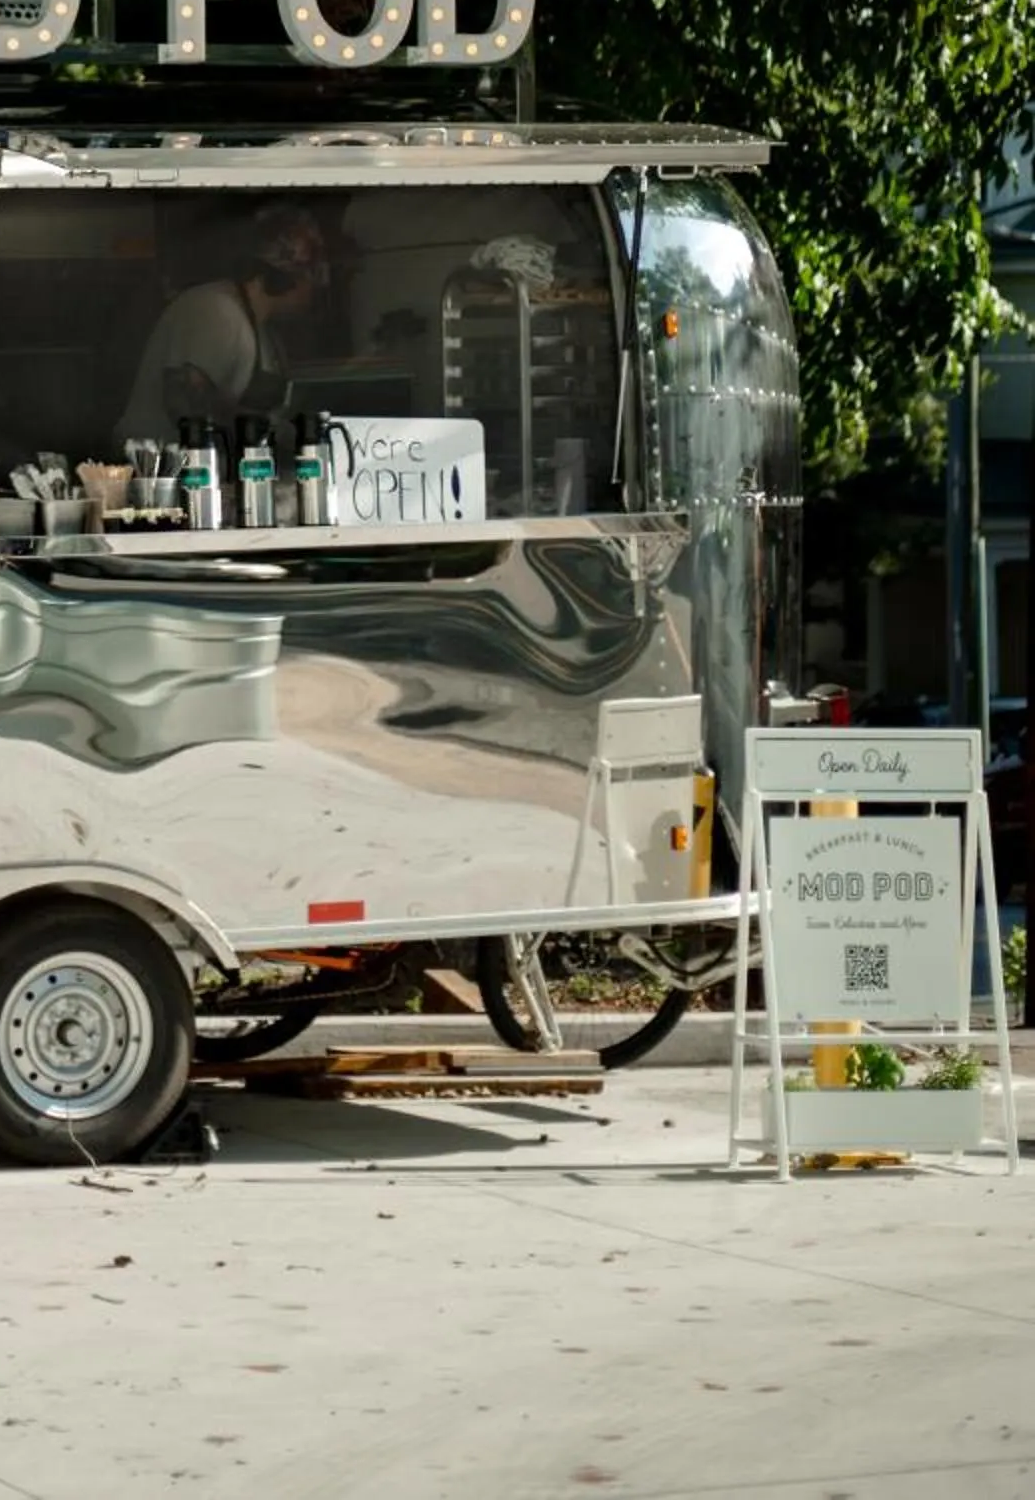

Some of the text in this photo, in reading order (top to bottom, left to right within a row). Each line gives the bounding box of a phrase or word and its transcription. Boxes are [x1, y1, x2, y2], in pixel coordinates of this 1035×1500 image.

[352, 464, 463, 522] OPEN!
[818, 748, 911, 782] Open Daily
[798, 871, 935, 901] MOD POD
